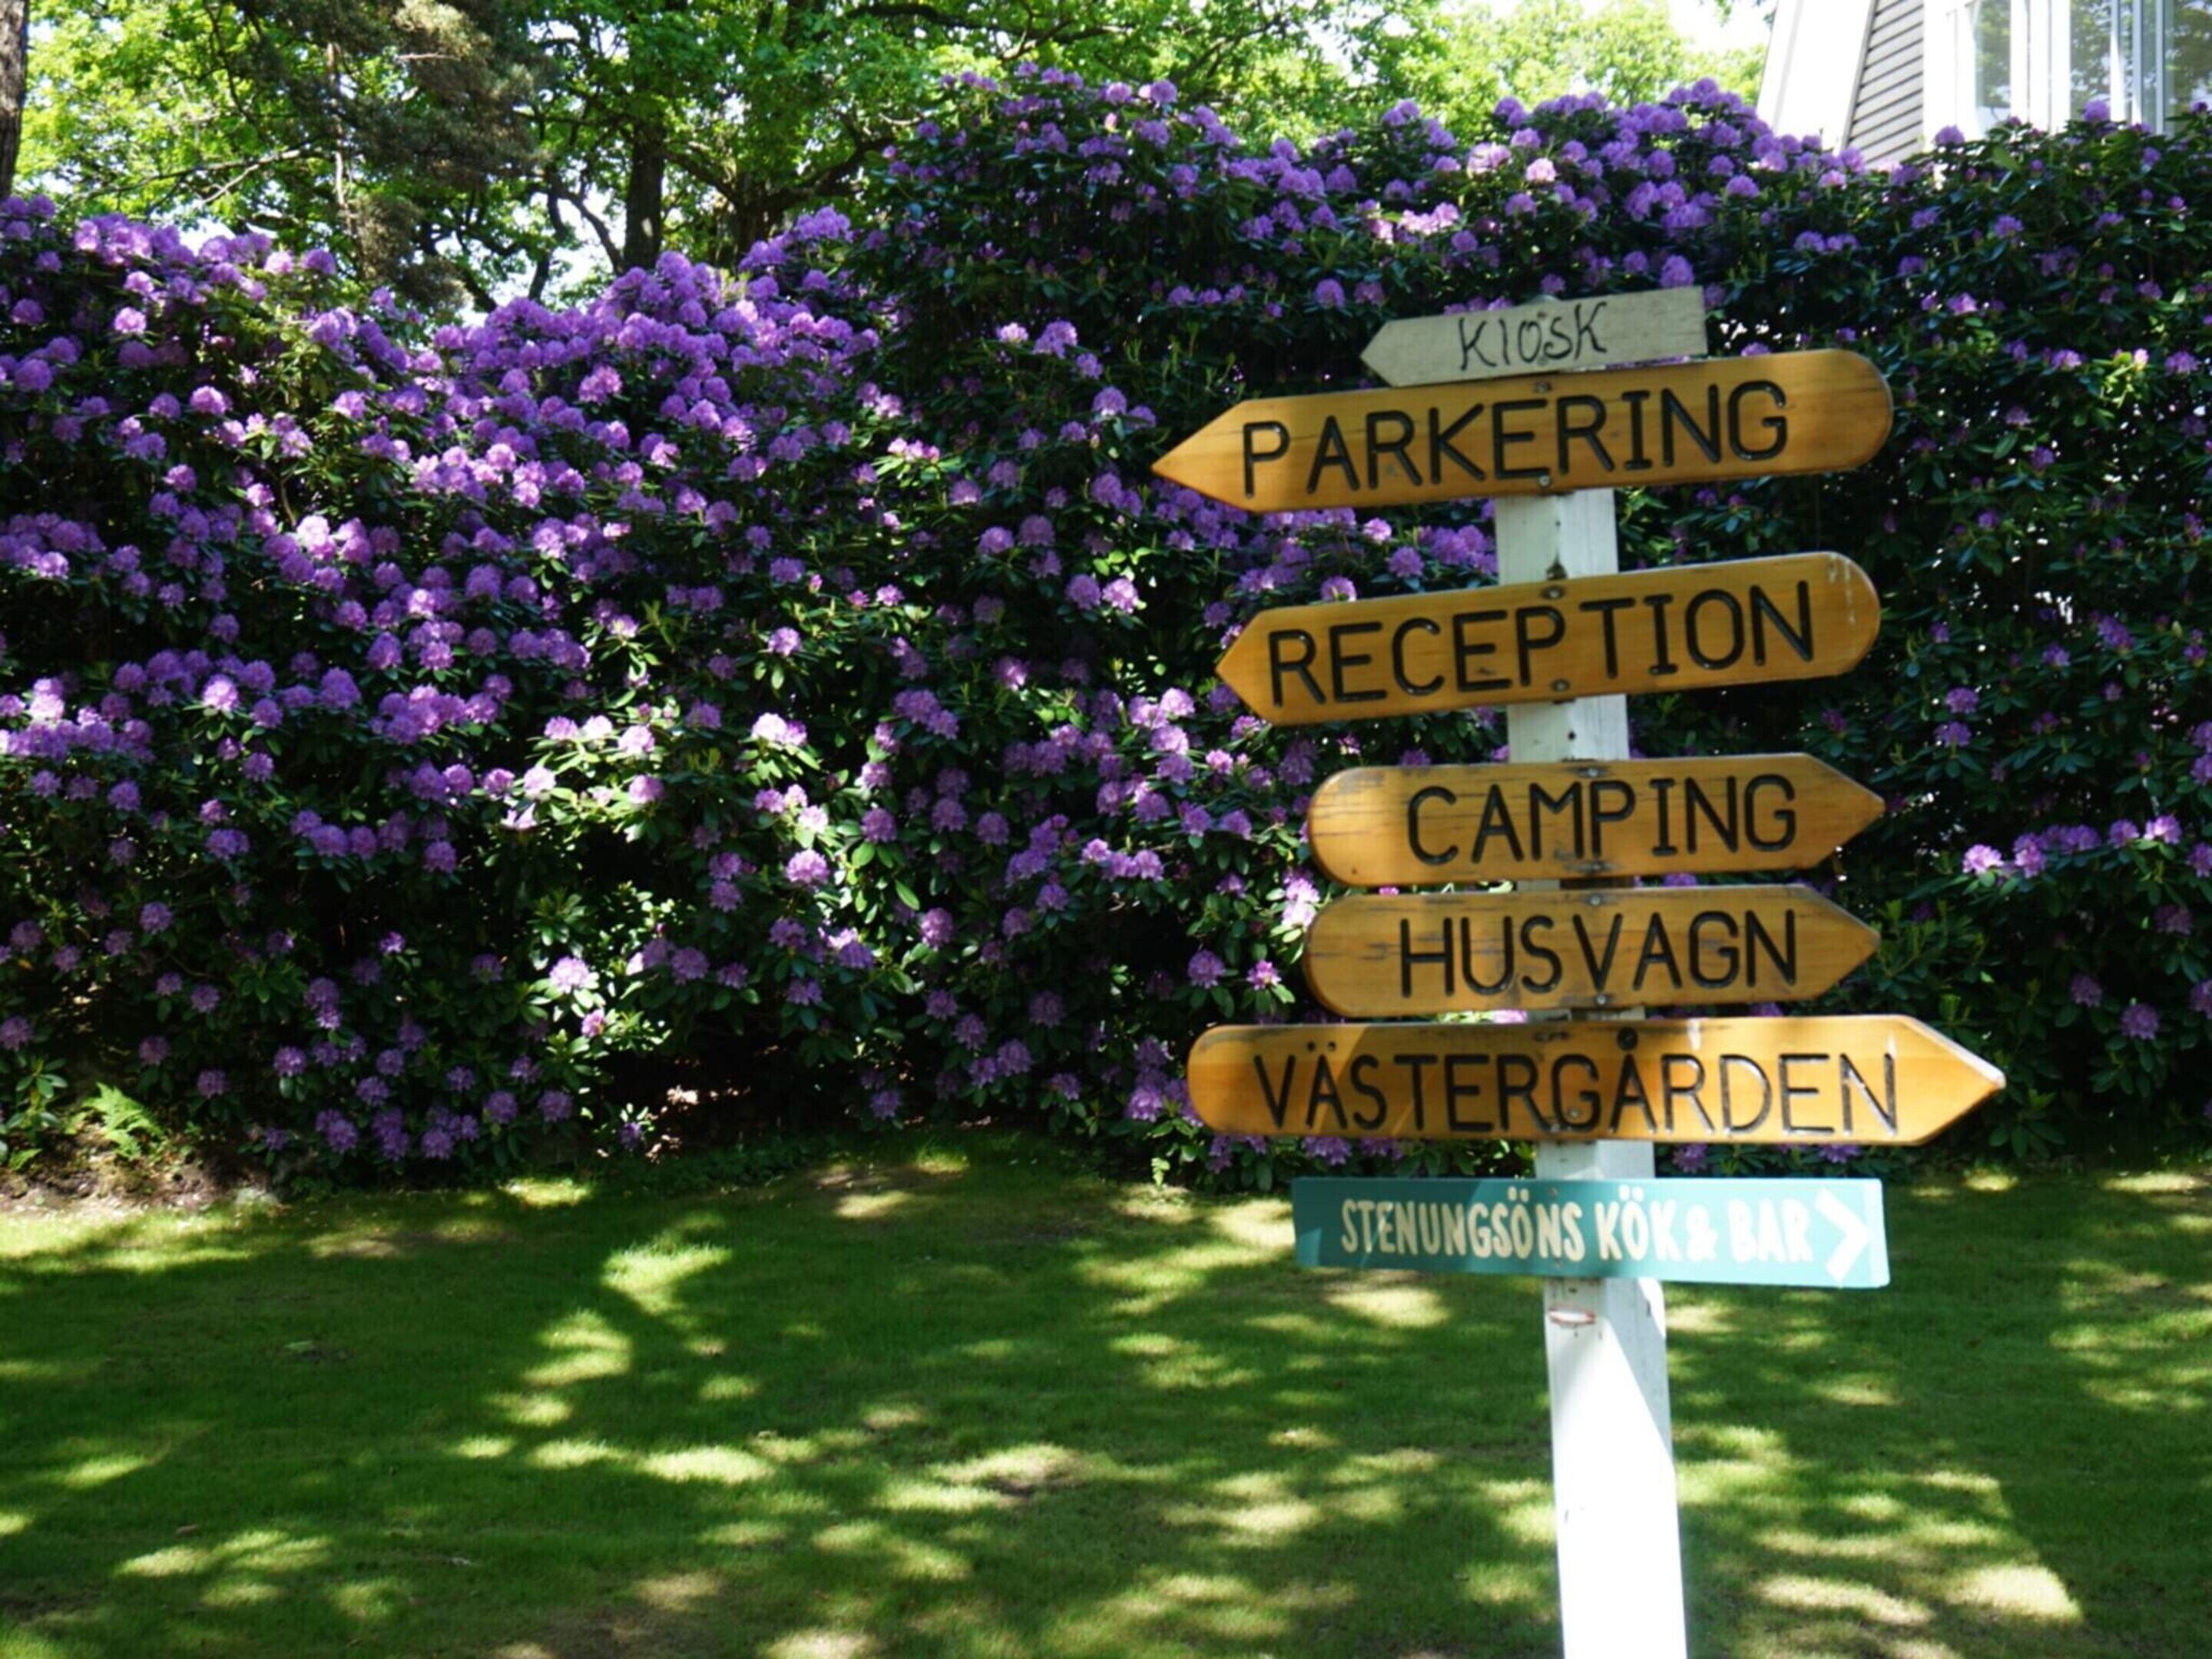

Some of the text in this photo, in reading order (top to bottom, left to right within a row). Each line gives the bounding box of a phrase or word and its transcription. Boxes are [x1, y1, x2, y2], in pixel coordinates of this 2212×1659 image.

[1458, 300, 1609, 371] KIOSK
[1242, 379, 1790, 499] PARKERING
[1267, 580, 1815, 707] RECEPTION
[1407, 773, 1796, 866] CAMPING
[1399, 909, 1796, 999] HUSVAGN
[1253, 1027, 1900, 1139] VÄSTERGÅRDEN
[1340, 1186, 1813, 1264] STENUNGSÖNS KÖK & BAR
